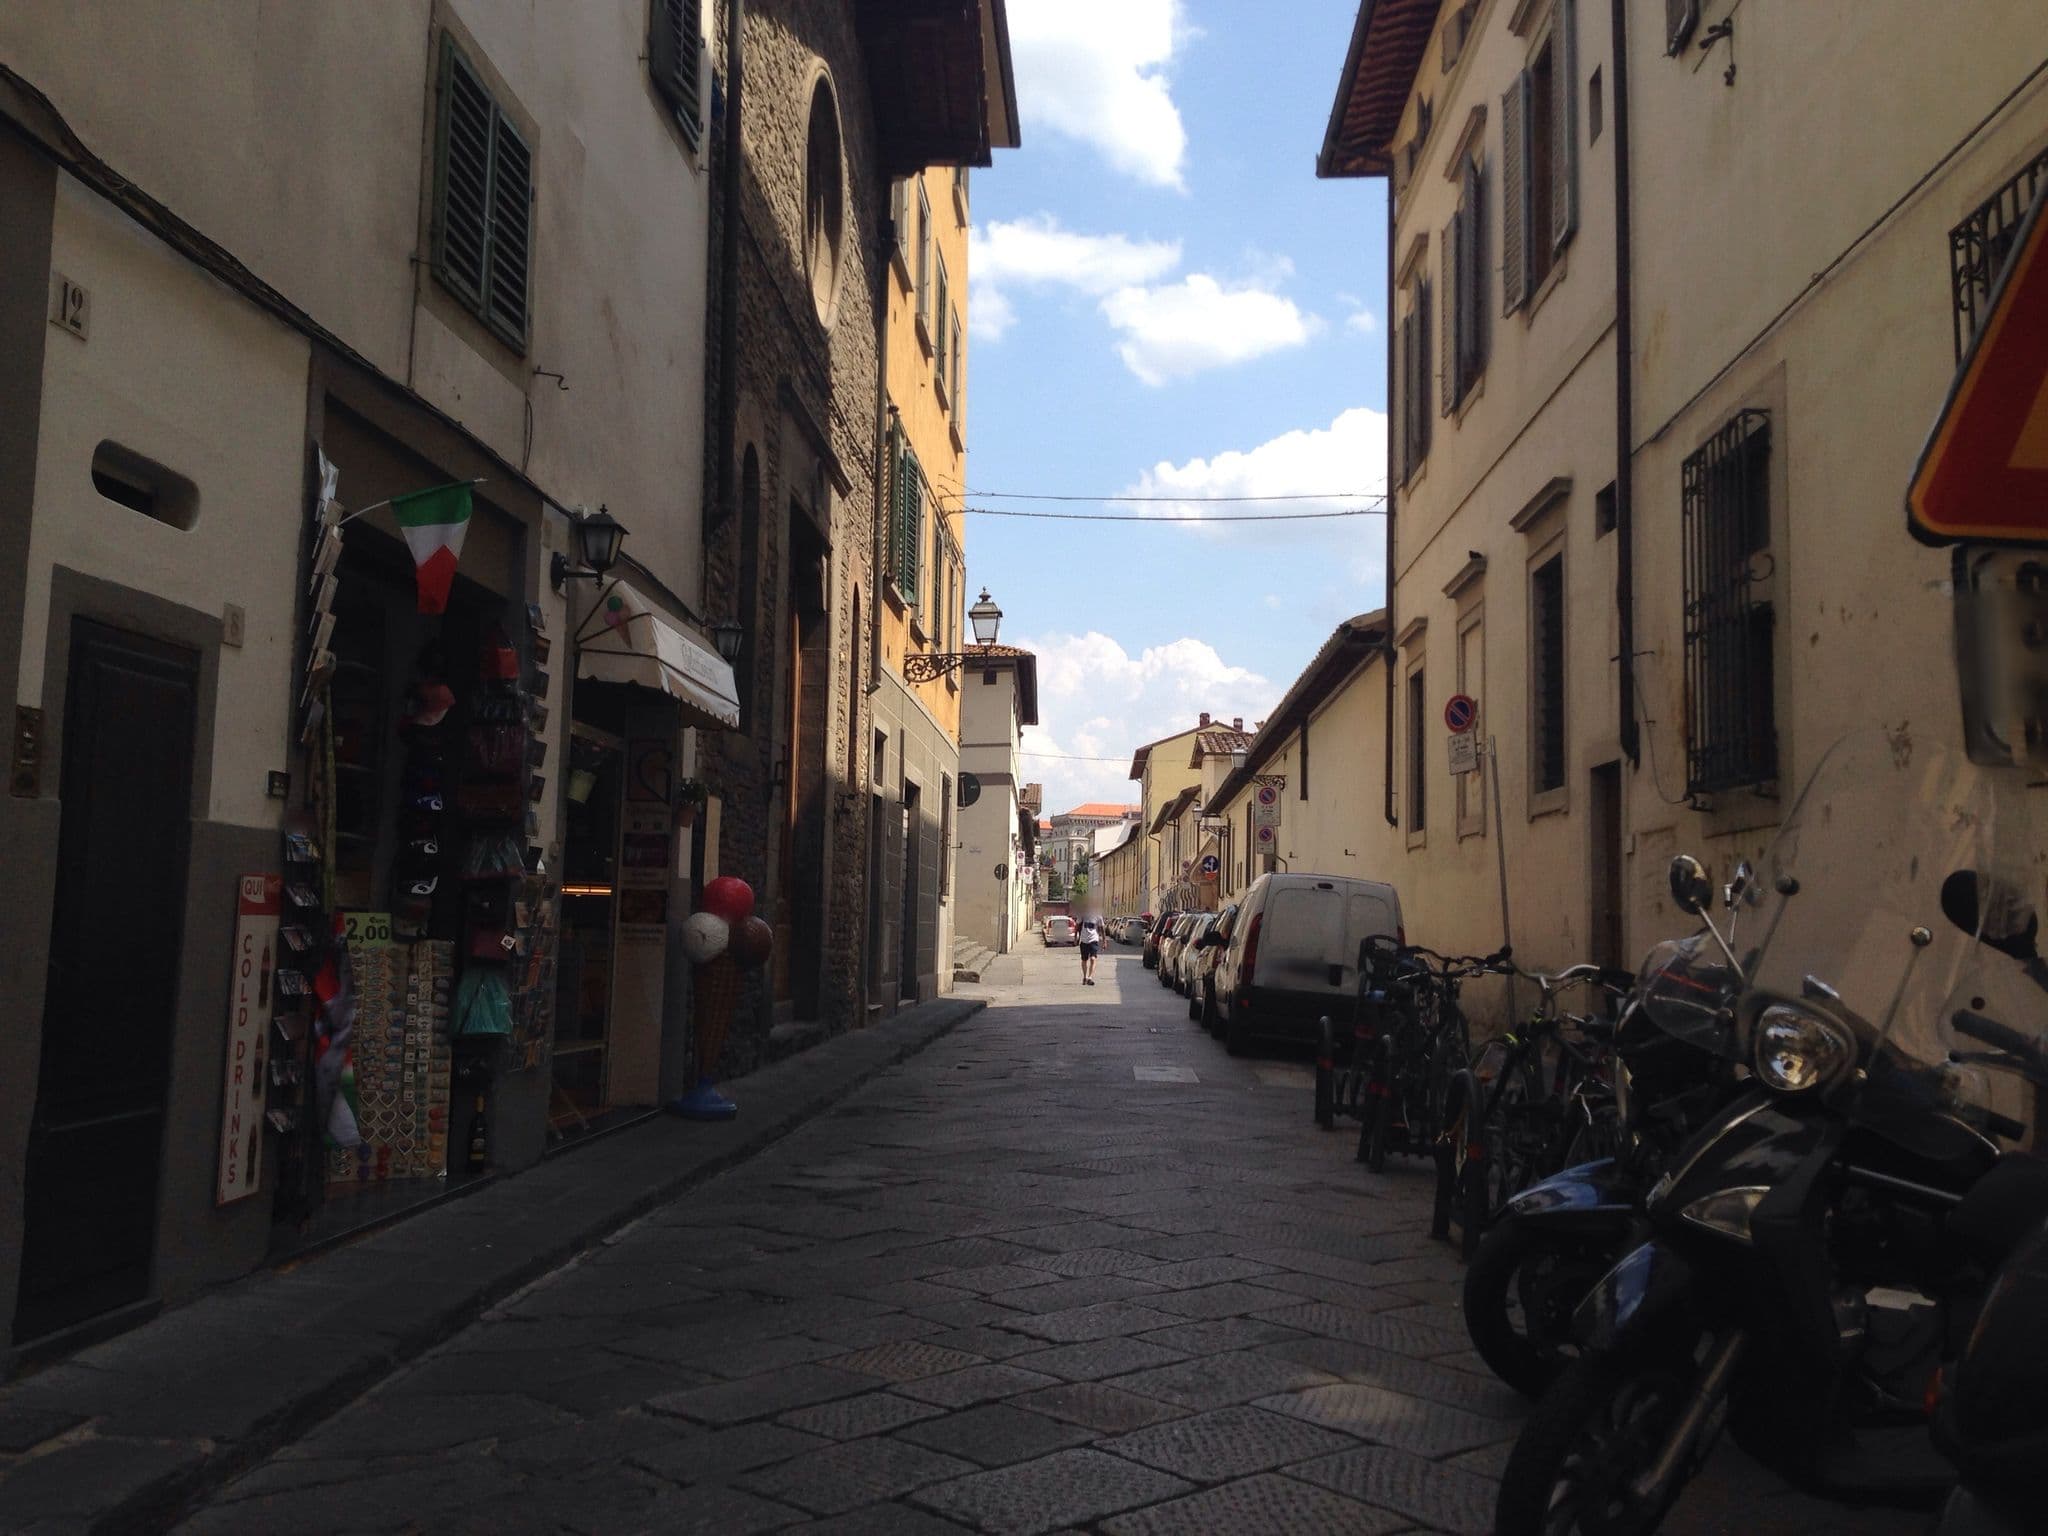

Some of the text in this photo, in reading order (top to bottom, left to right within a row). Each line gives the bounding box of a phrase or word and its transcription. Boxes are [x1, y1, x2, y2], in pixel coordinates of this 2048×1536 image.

[62, 281, 83, 329] 12
[346, 918, 388, 943] 2,00
[228, 934, 253, 1184] COLD DRINKS
